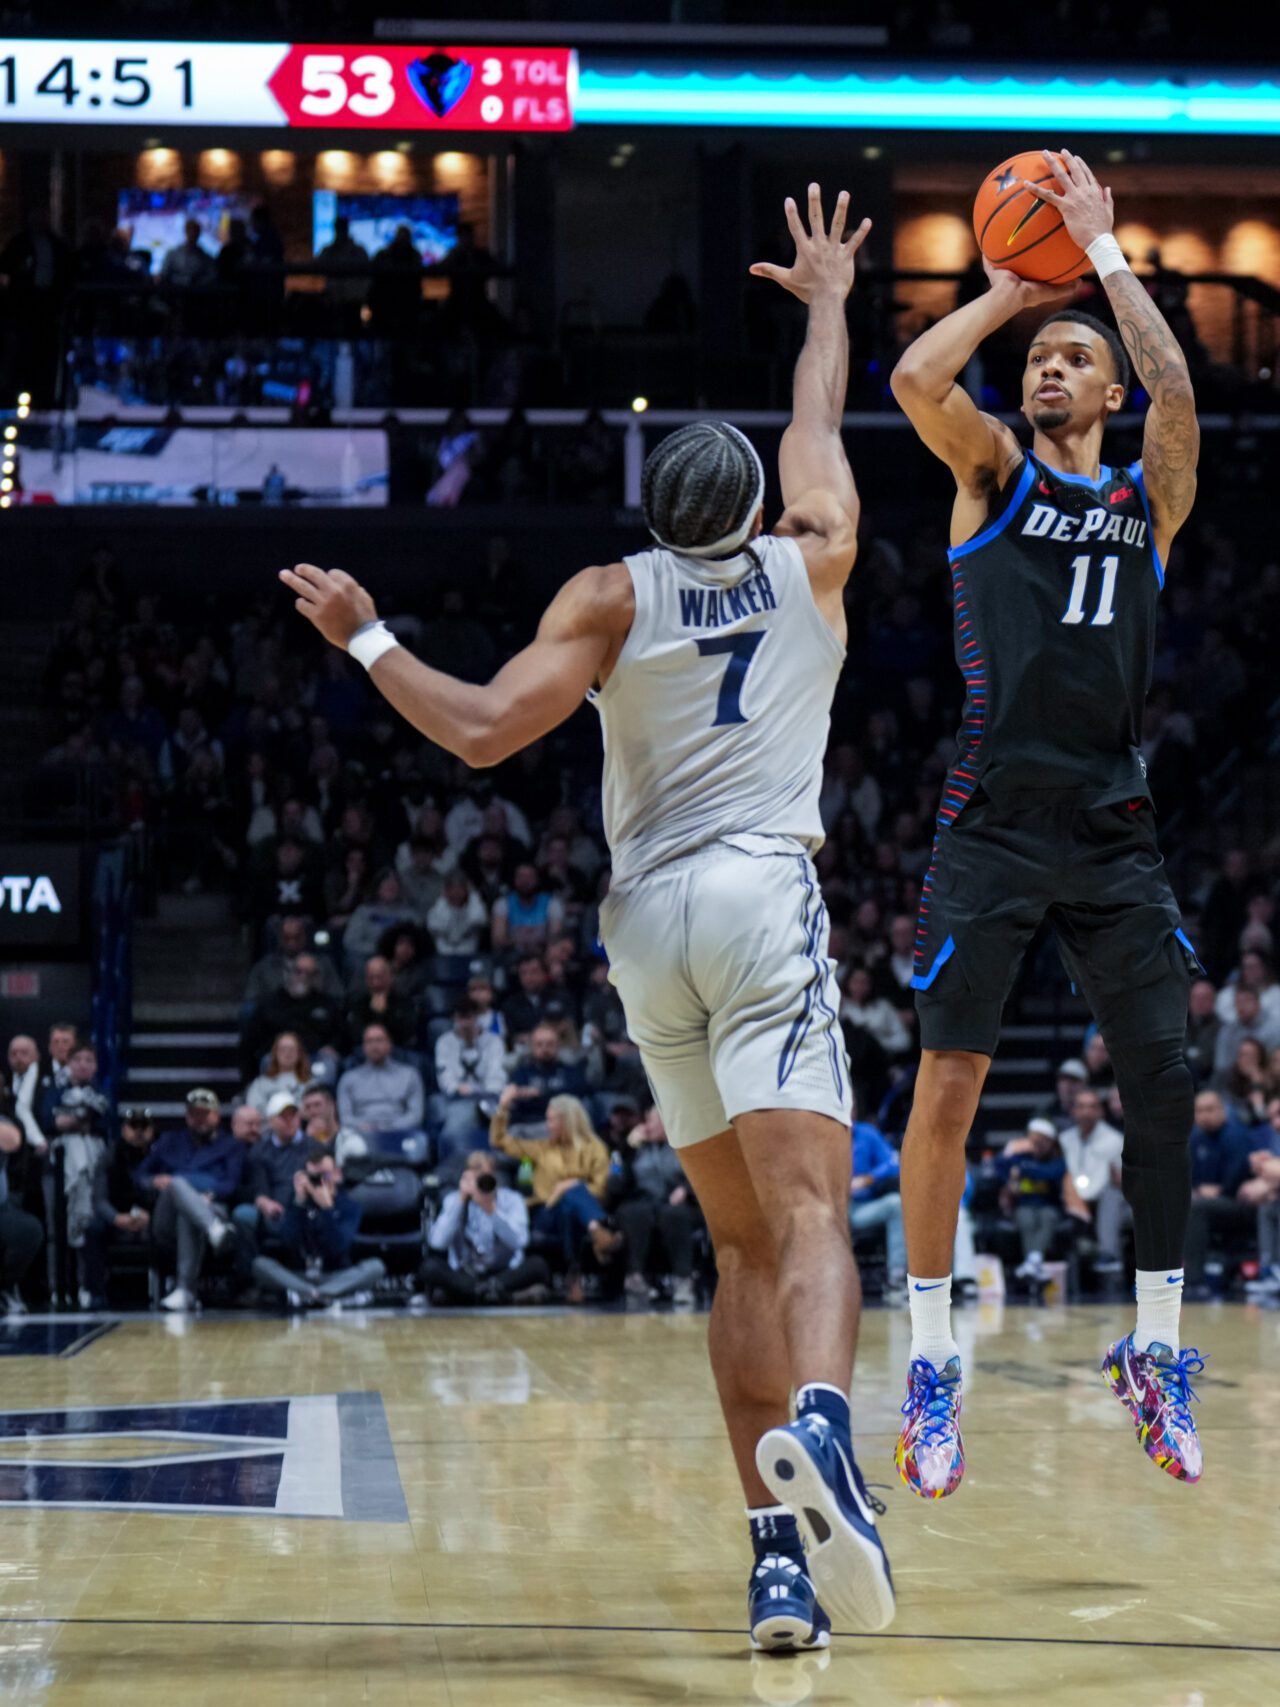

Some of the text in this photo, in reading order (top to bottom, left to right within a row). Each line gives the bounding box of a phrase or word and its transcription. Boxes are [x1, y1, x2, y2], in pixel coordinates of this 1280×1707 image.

[0, 56, 194, 109] 14:51
[299, 55, 396, 117] 53
[481, 58, 566, 87] 3 TOL
[480, 95, 565, 124] 0 FLS
[678, 571, 778, 628] WALKER
[1061, 555, 1119, 625] 11
[691, 629, 770, 727] 7
